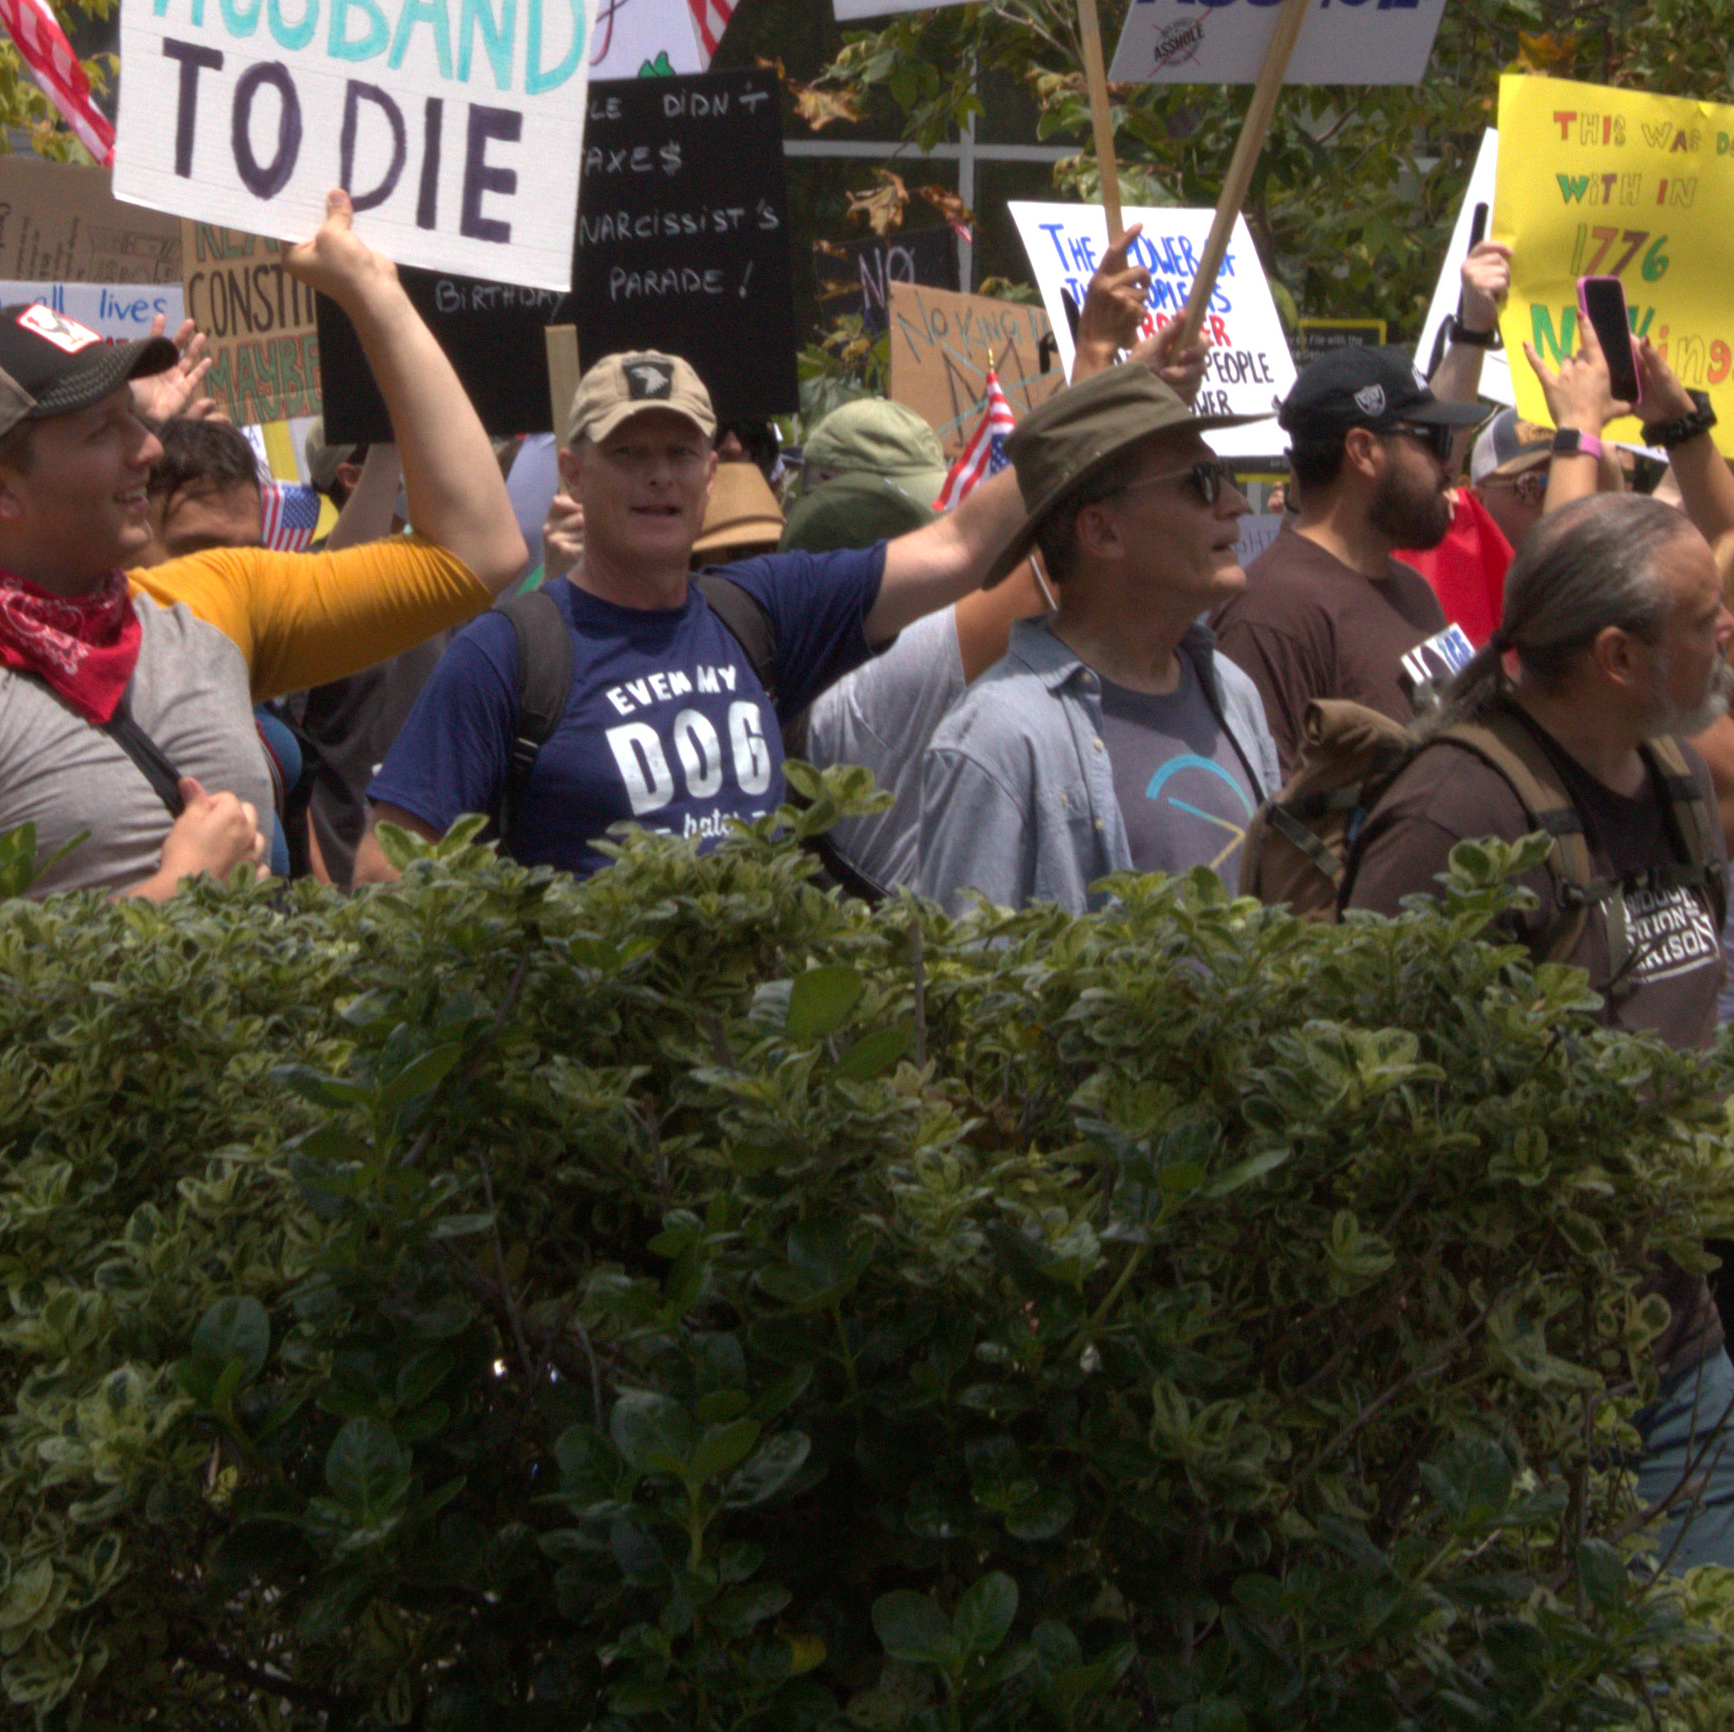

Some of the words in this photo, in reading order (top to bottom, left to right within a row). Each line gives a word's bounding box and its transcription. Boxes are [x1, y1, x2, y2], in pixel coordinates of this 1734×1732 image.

[163, 36, 303, 202] TO
[340, 79, 523, 244] DIE
[1553, 110, 1626, 147] THIS
[1641, 122, 1702, 154] WAS
[1656, 178, 1698, 209] IN
[1038, 223, 1097, 273] THE
[1570, 222, 1670, 282] 1776
[99, 288, 168, 324] lives
[897, 288, 951, 364] NO
[201, 332, 323, 427] MAYBE
[1203, 350, 1275, 384] PEOPLE
[605, 670, 694, 716] EVEN
[696, 664, 737, 694] MY
[605, 700, 772, 817] DOG
